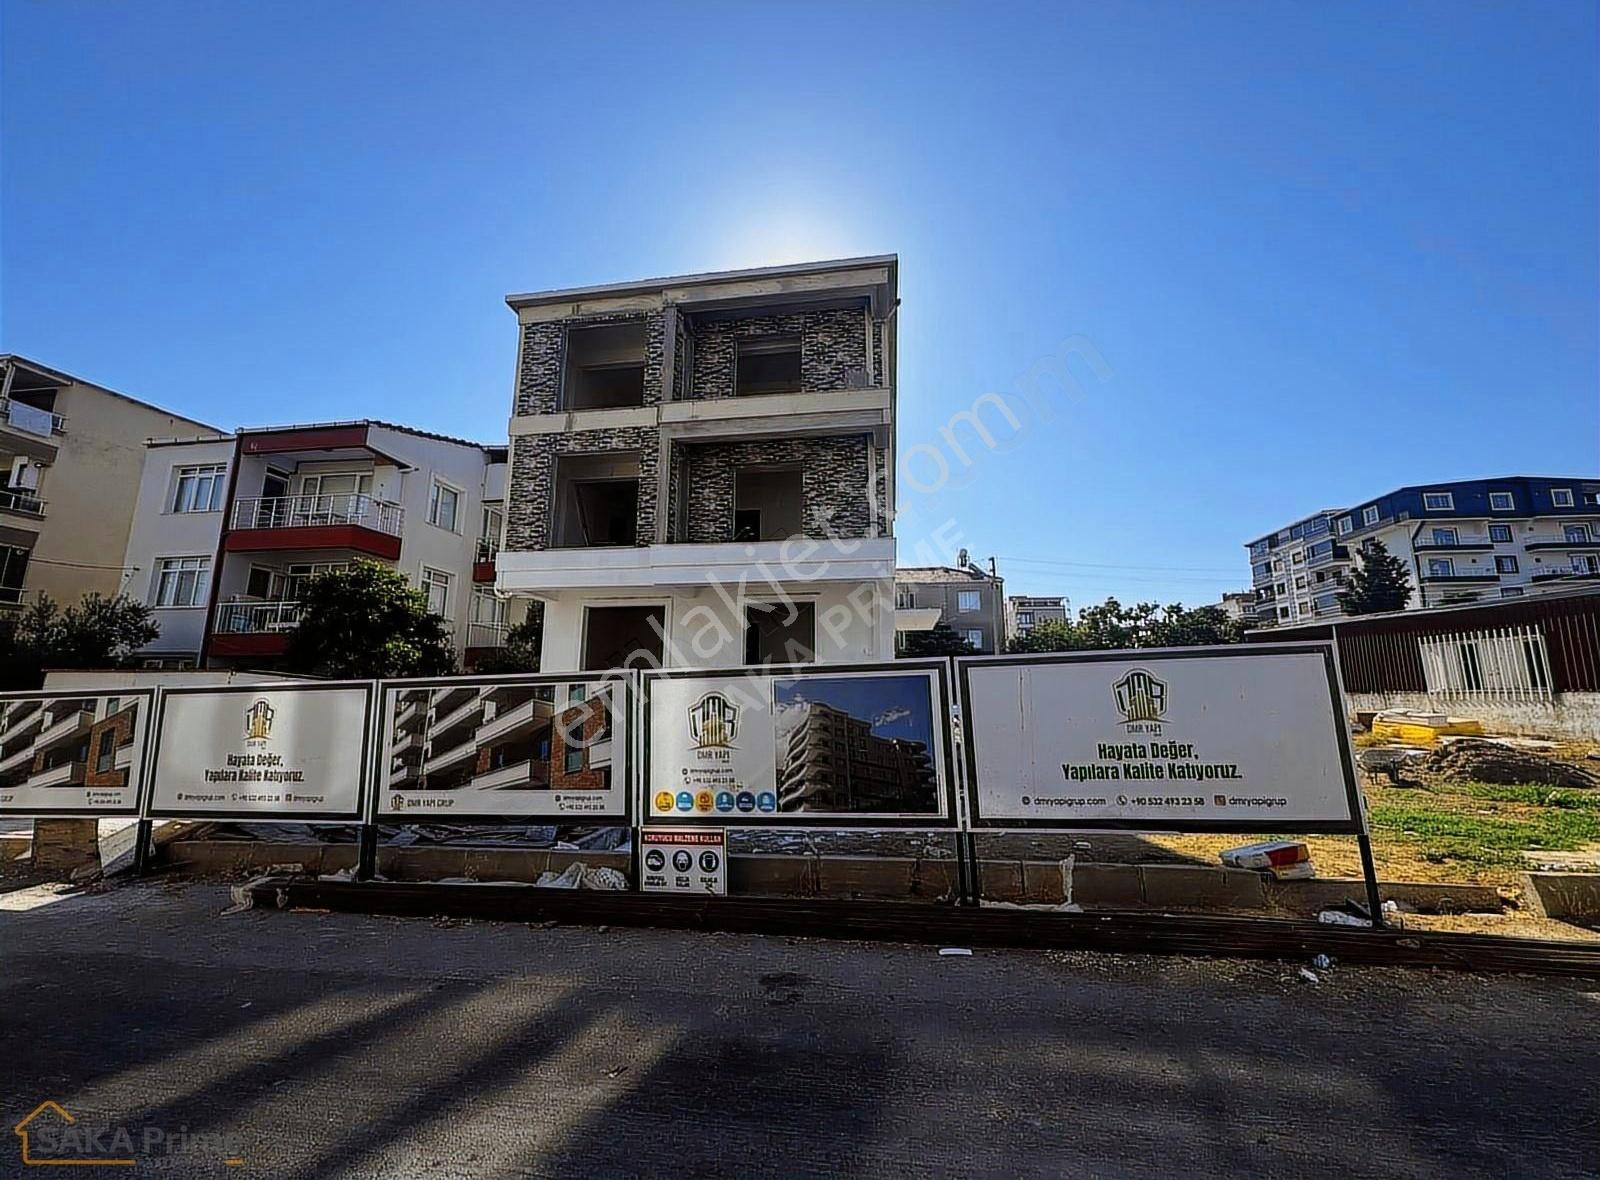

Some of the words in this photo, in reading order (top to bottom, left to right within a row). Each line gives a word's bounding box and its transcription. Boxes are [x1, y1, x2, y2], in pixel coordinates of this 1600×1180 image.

[1098, 743, 1147, 761] Hayata
[1151, 740, 1199, 760] Değer,
[227, 753, 255, 767] Hayata
[1062, 763, 1120, 782] Yapılara
[1123, 762, 1164, 780] Kalite
[1168, 762, 1243, 781] Katıyoruz.
[1229, 795, 1288, 807] dmryapigrup
